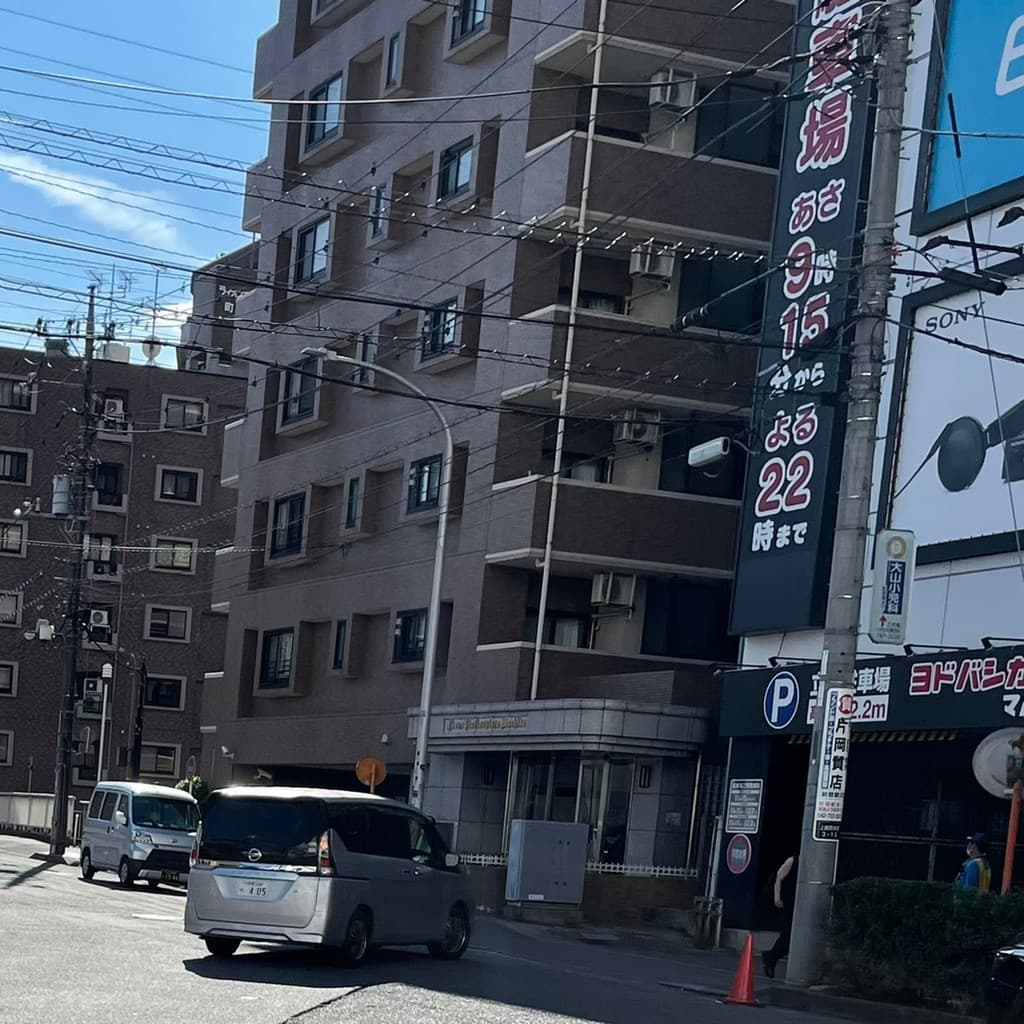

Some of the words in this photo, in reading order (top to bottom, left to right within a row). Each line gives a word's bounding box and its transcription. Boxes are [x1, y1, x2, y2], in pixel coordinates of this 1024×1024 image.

[789, 178, 845, 234] あさ
[926, 302, 986, 333] SONY
[765, 402, 818, 453] よる
[755, 450, 814, 518] 22
[751, 519, 808, 552] 時まで
[771, 678, 795, 723] P
